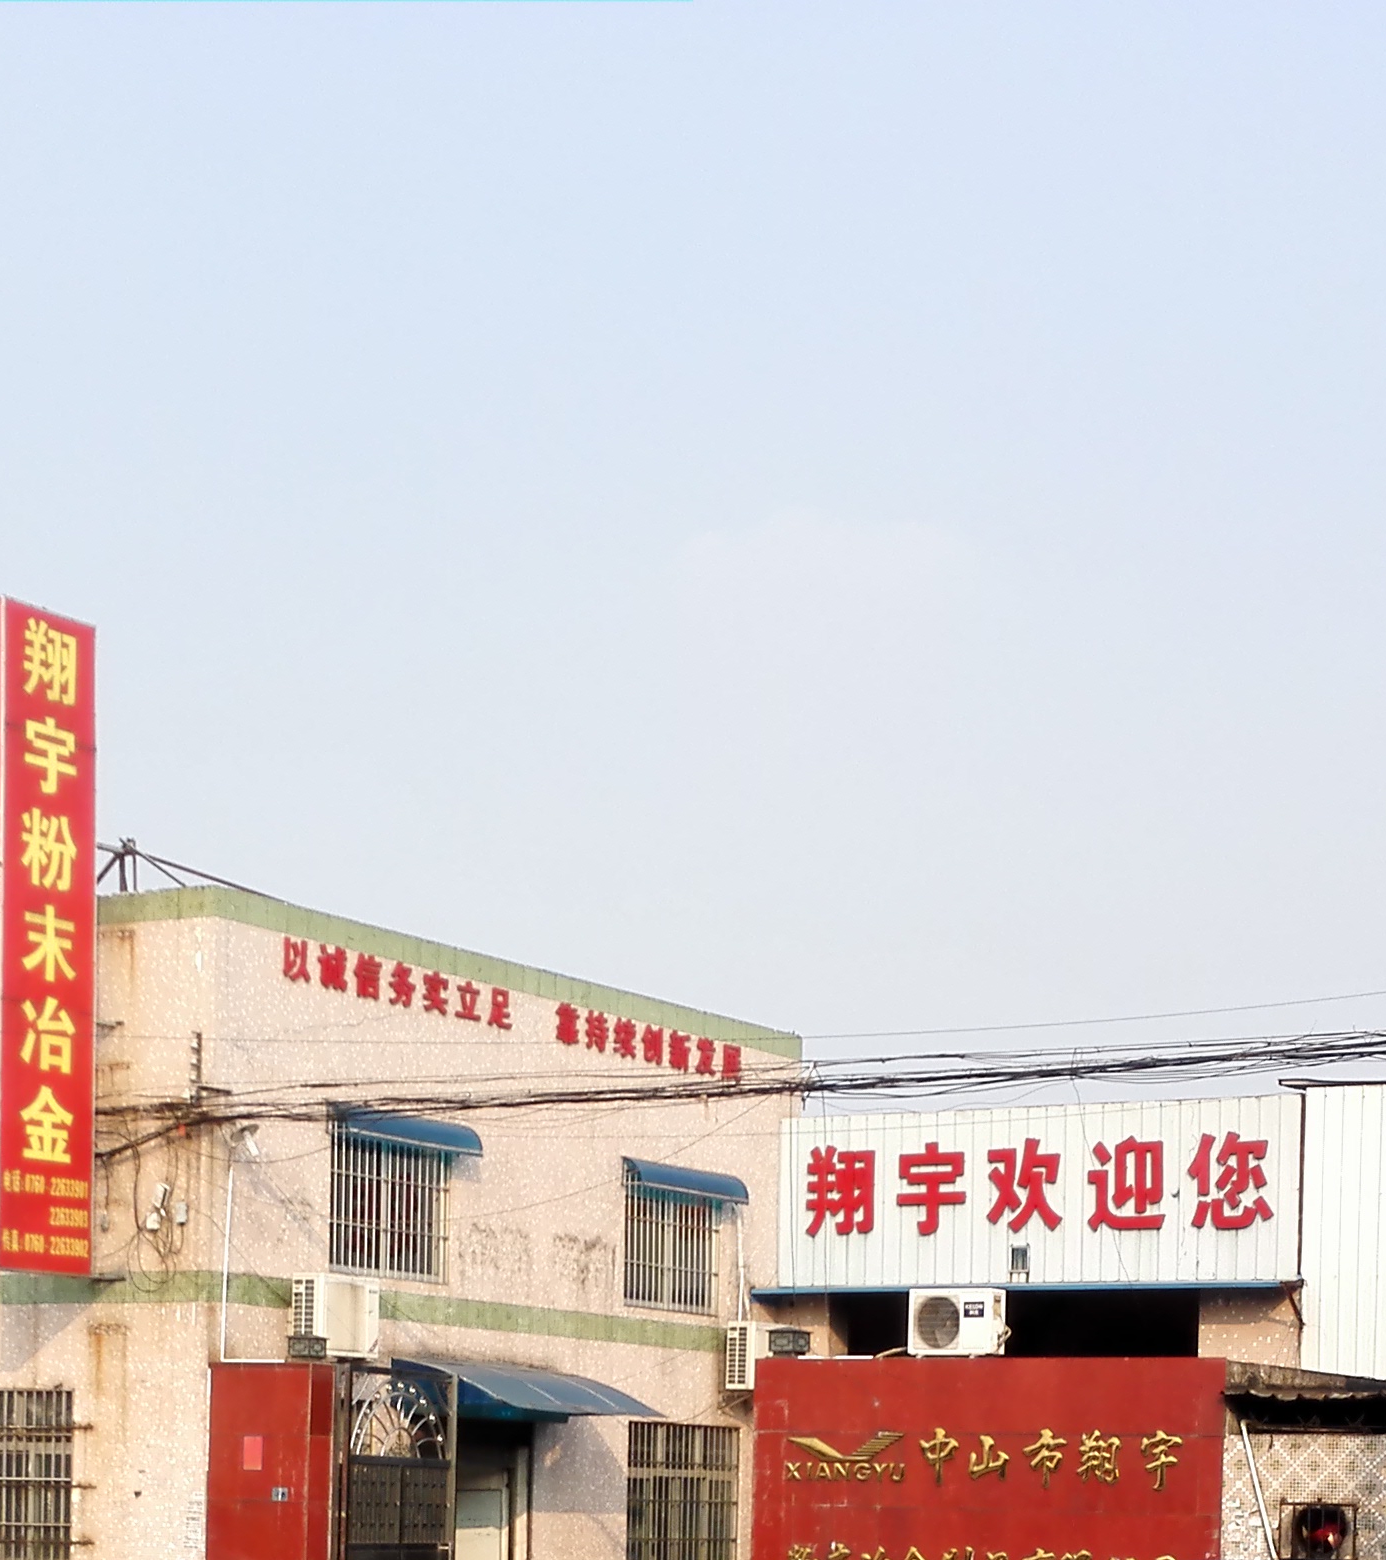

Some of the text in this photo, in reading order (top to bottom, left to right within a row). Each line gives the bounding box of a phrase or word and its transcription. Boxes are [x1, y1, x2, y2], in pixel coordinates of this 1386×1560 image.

[19, 617, 78, 1164] 翔宇粉末冶金
[282, 936, 513, 1031] 以诚信务实立足
[805, 1131, 1275, 1237] 翔宇欢迎您
[786, 1461, 906, 1483] XIANGYU
[917, 1427, 1185, 1492] 中山市翔宇
